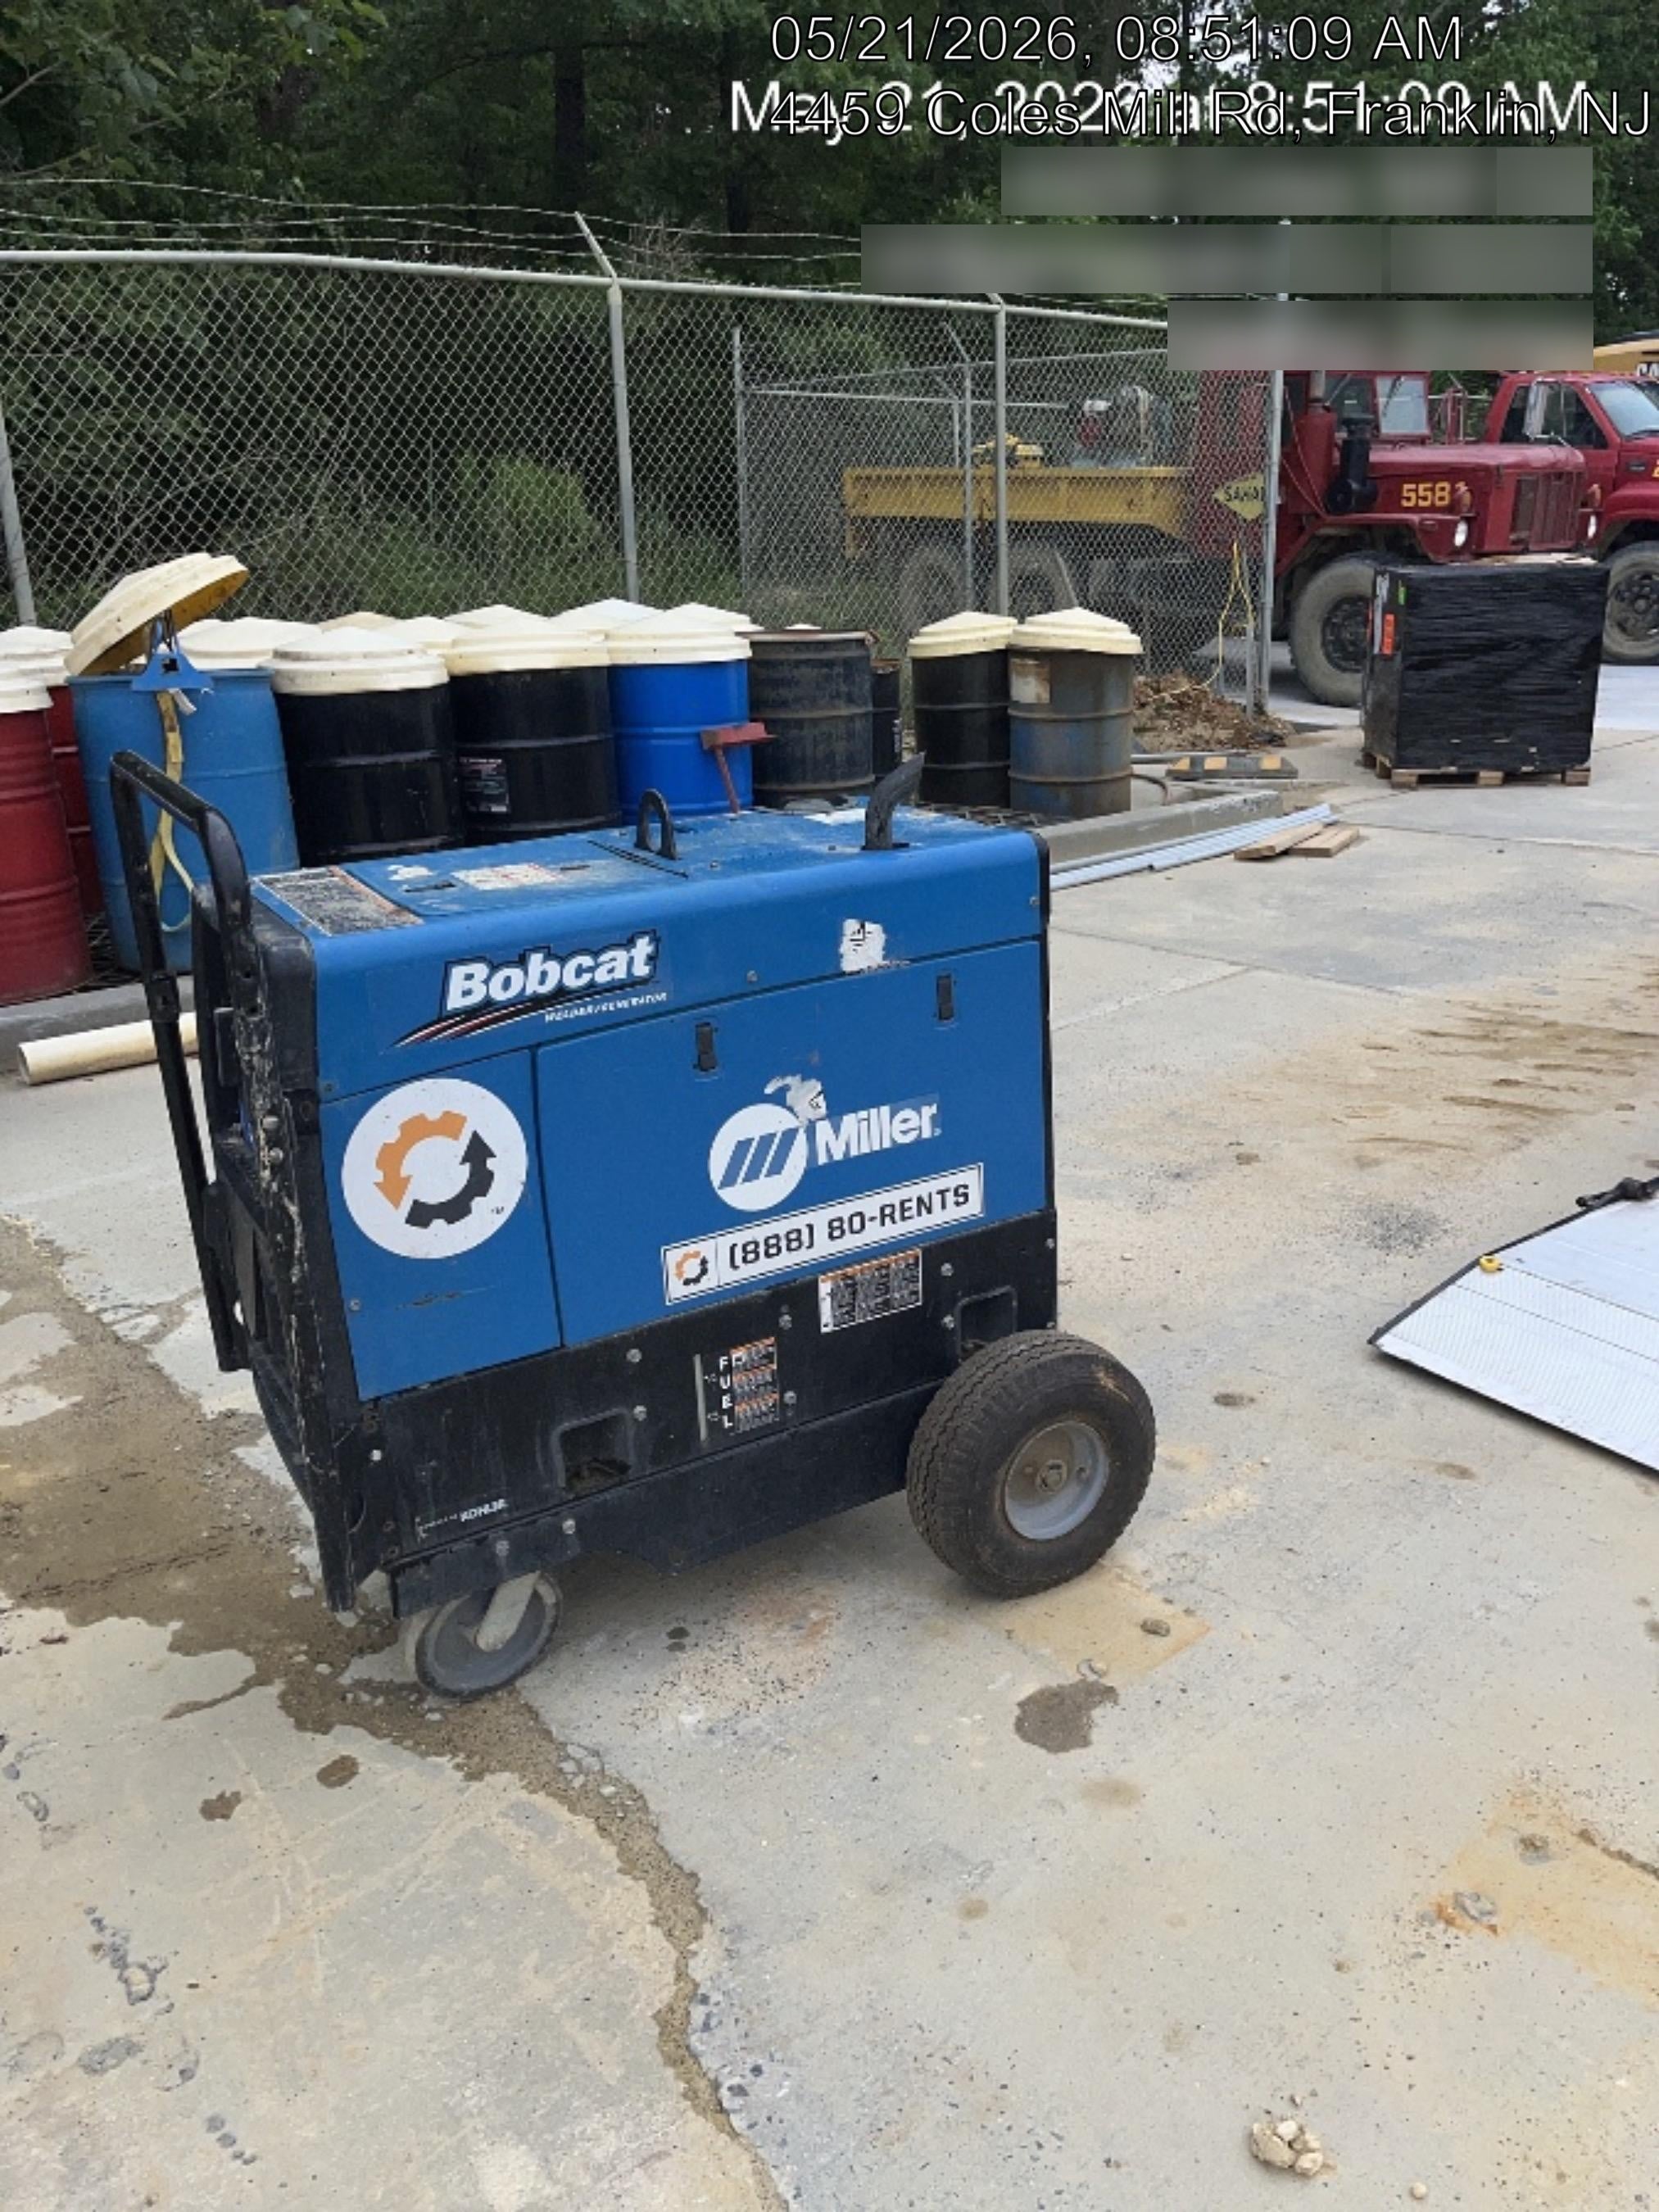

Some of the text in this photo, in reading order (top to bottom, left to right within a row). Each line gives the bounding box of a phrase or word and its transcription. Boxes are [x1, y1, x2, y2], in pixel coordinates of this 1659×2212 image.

[1401, 482, 1451, 507] 558
[444, 932, 657, 1013] Bobcat
[816, 1104, 937, 1166] Miller
[729, 1184, 970, 1270] (888) 80-RENTS
